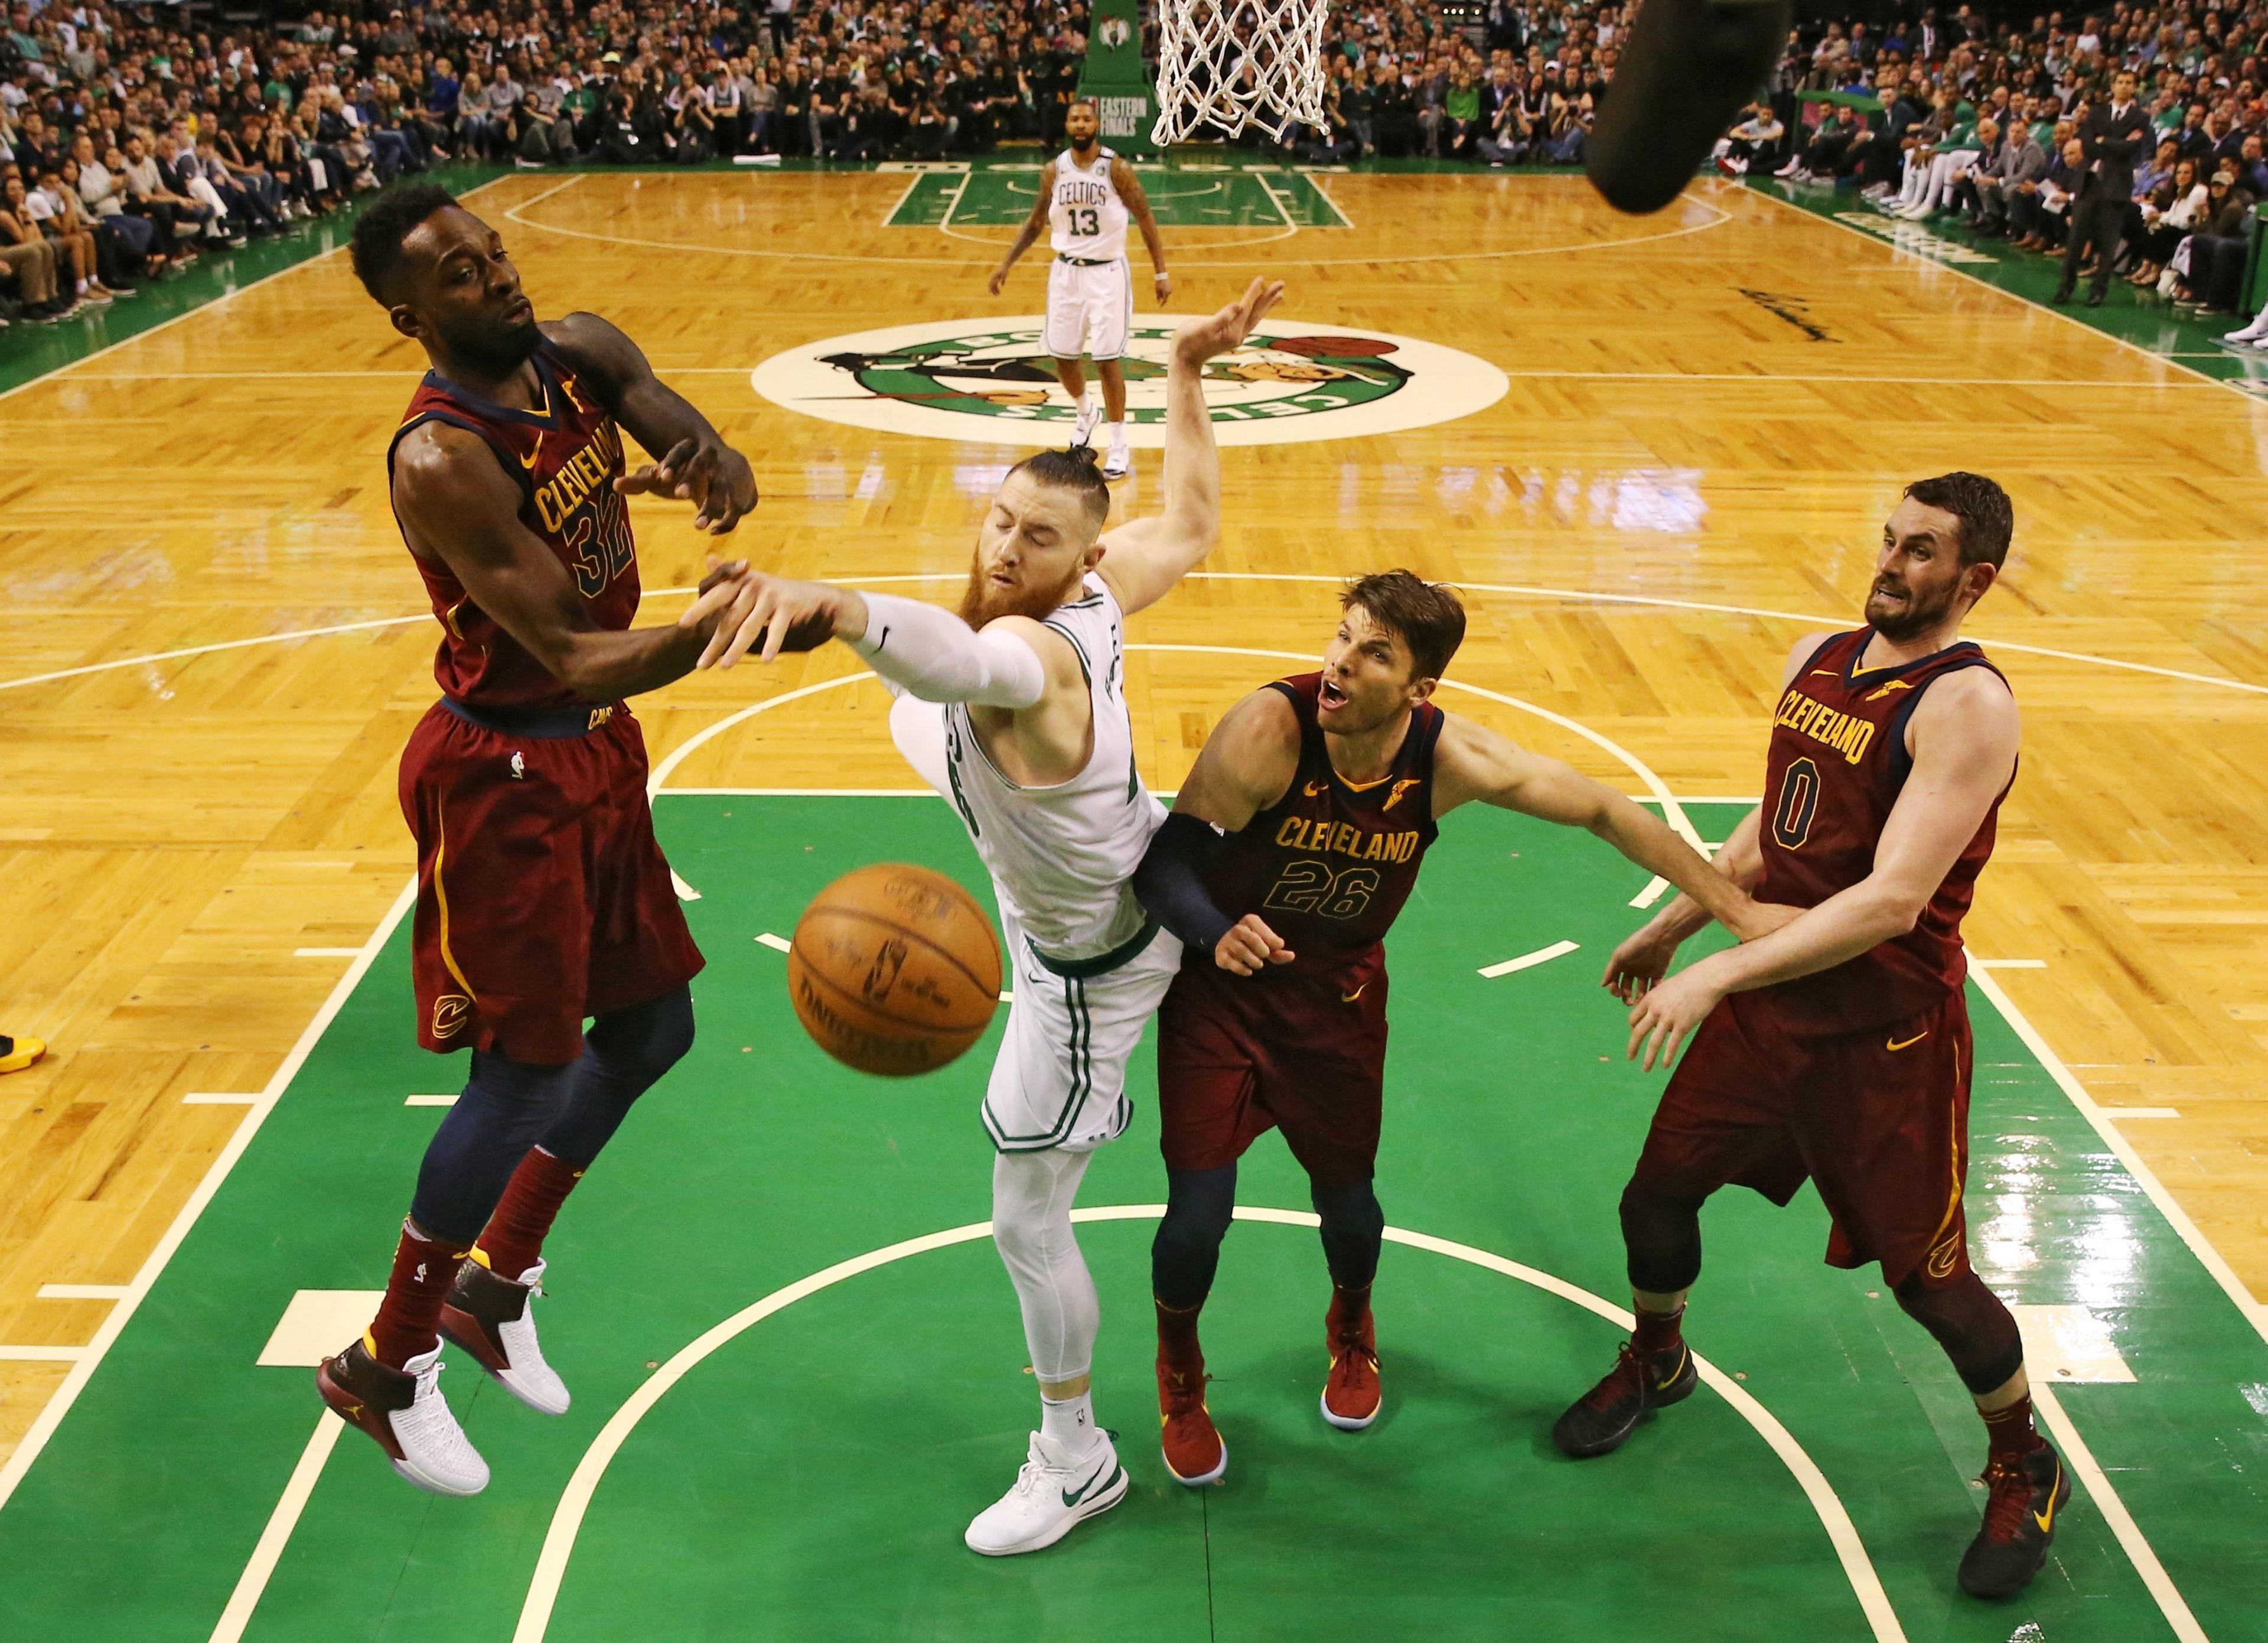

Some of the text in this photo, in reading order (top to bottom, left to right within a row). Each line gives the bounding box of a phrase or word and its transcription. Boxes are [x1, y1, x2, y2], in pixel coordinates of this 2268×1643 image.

[1100, 97, 1147, 118] EASTERN
[1100, 117, 1137, 136] FINALS
[1059, 182, 1106, 206] CELTICS
[1068, 209, 1100, 236] 13
[562, 475, 634, 599] 32
[1774, 689, 1875, 766] CLEVELAND
[1772, 756, 1821, 851] 0
[1275, 816, 1419, 864] CLEVELAND
[1263, 860, 1380, 920] 26
